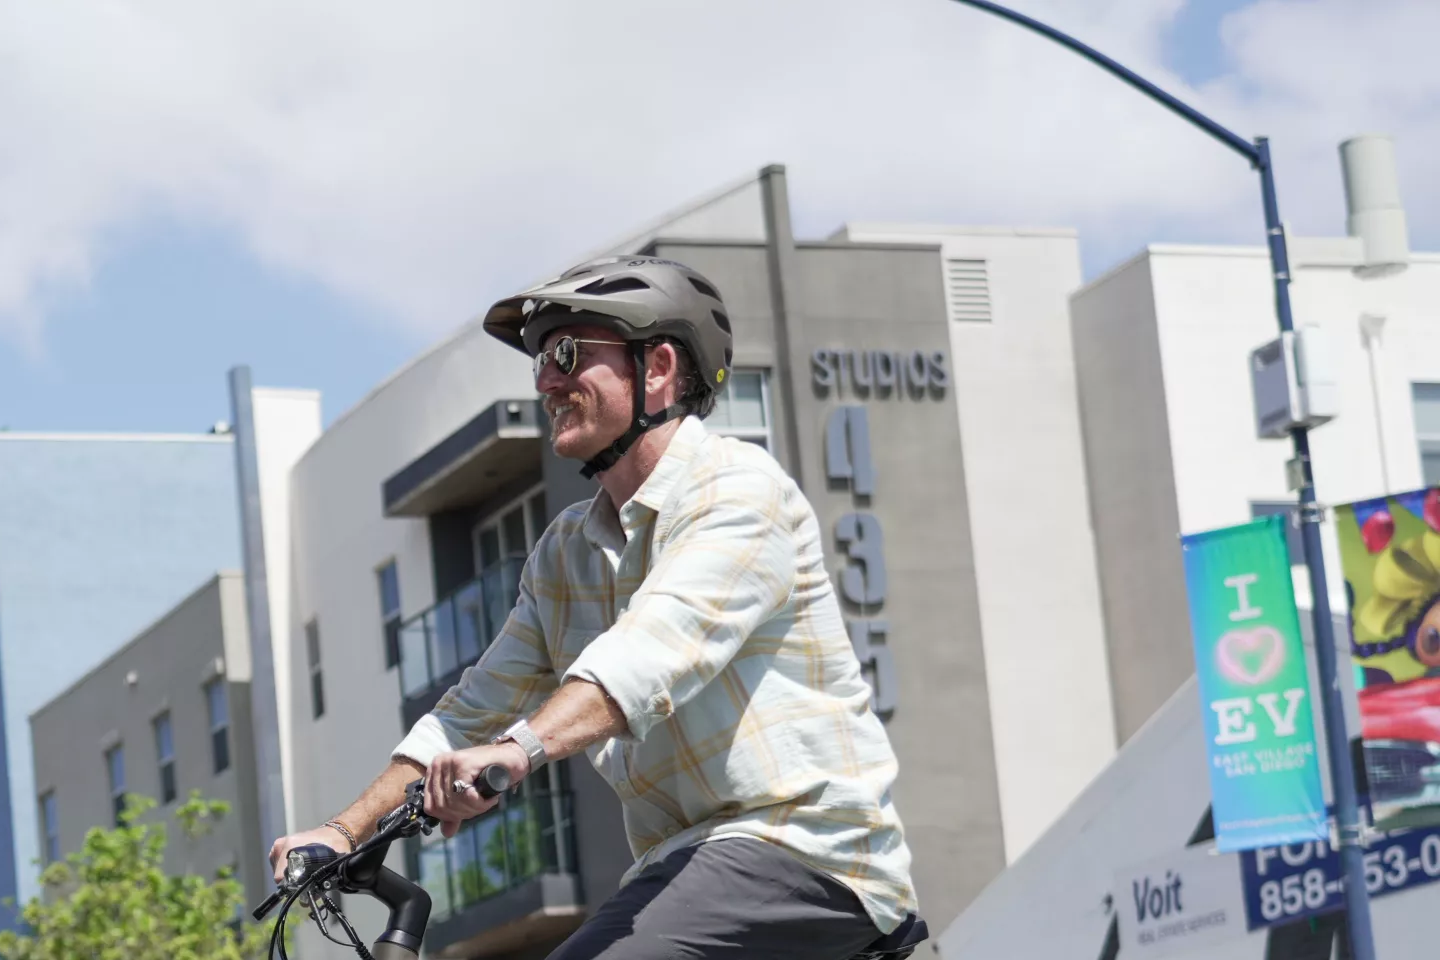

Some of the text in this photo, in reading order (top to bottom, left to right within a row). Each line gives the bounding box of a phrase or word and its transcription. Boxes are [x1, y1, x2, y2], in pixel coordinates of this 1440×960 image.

[811, 347, 949, 395] STUDIOS
[1223, 572, 1263, 622] I
[1210, 687, 1305, 746] EV
[1254, 741, 1314, 762] VILLAGE
[1132, 869, 1183, 923] Voit
